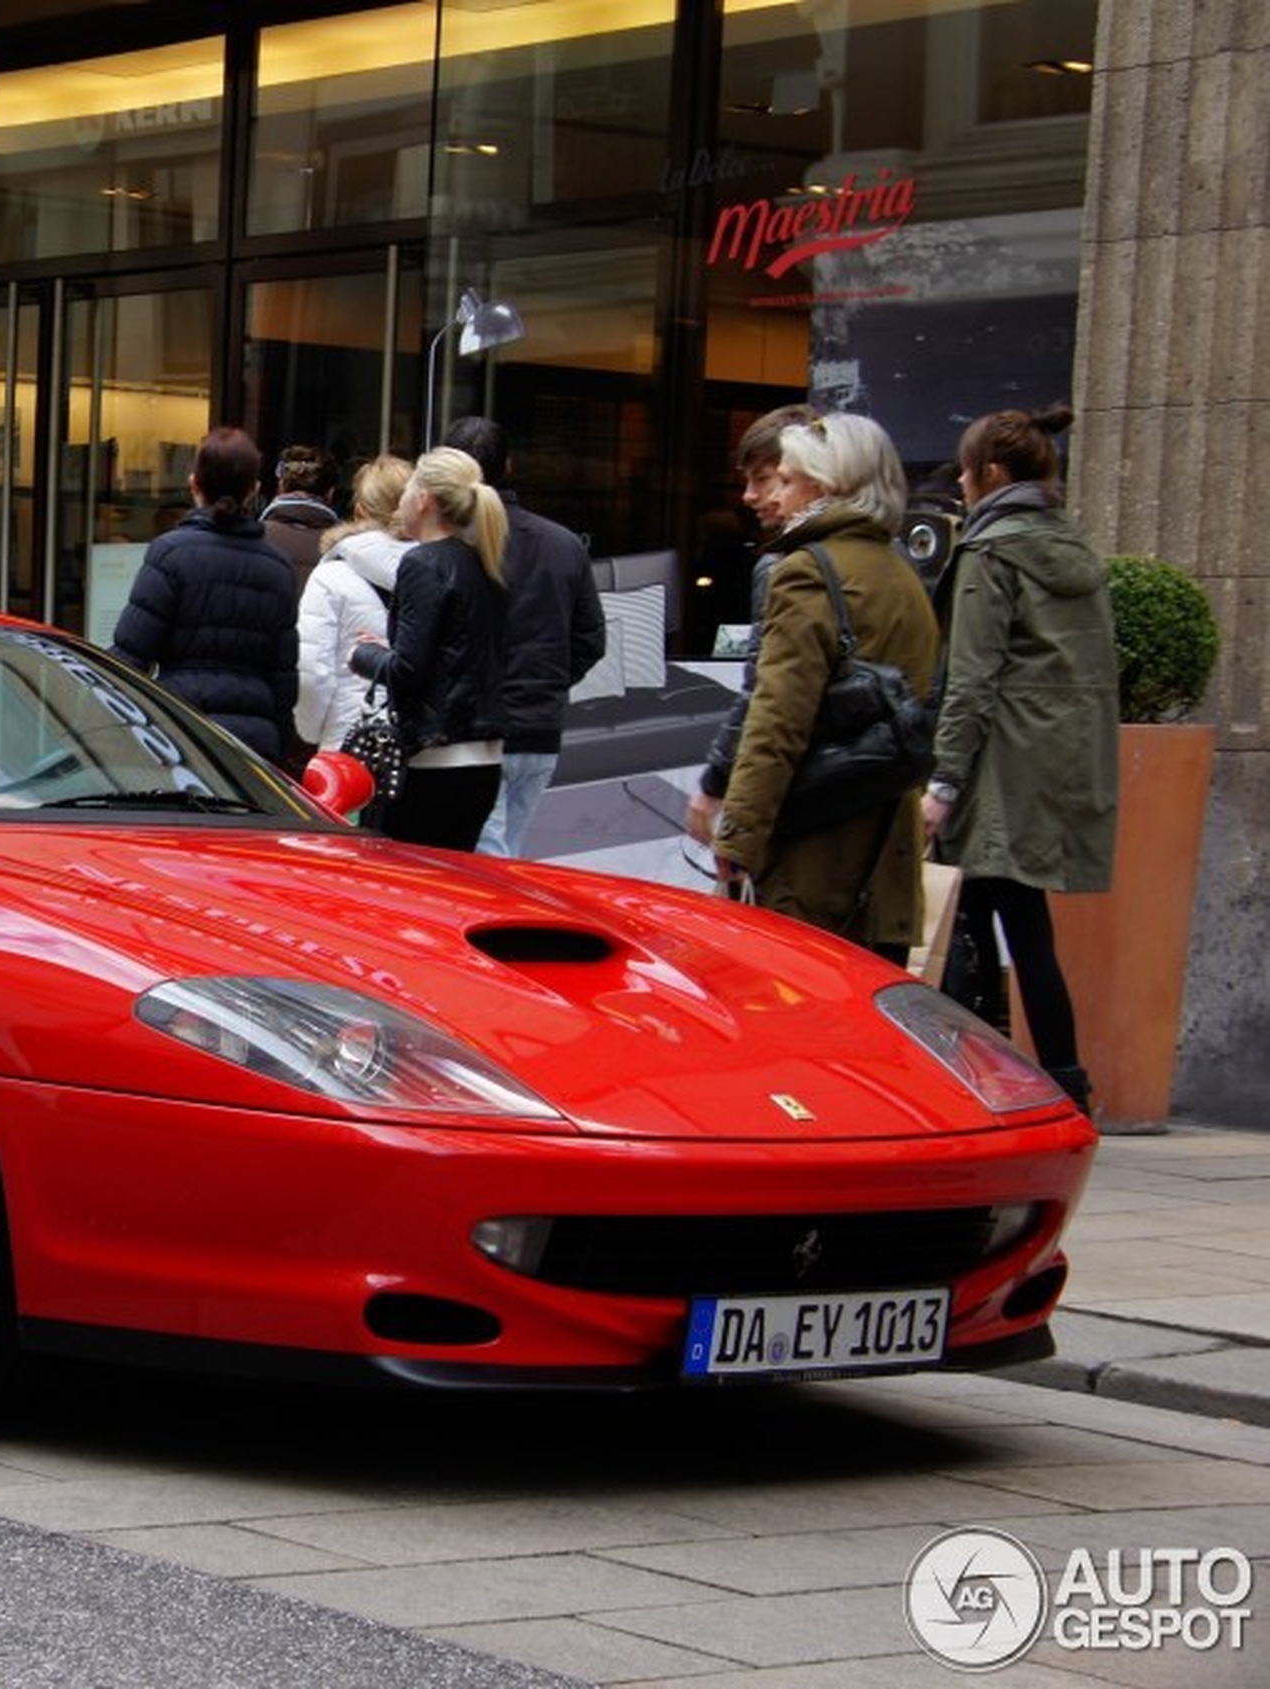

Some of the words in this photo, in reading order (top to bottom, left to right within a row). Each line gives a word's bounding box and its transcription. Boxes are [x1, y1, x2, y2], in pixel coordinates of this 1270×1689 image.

[706, 171, 915, 273] Maestria
[715, 1307, 765, 1363] DA
[793, 1303, 844, 1359] EY
[849, 1298, 942, 1354] 1013
